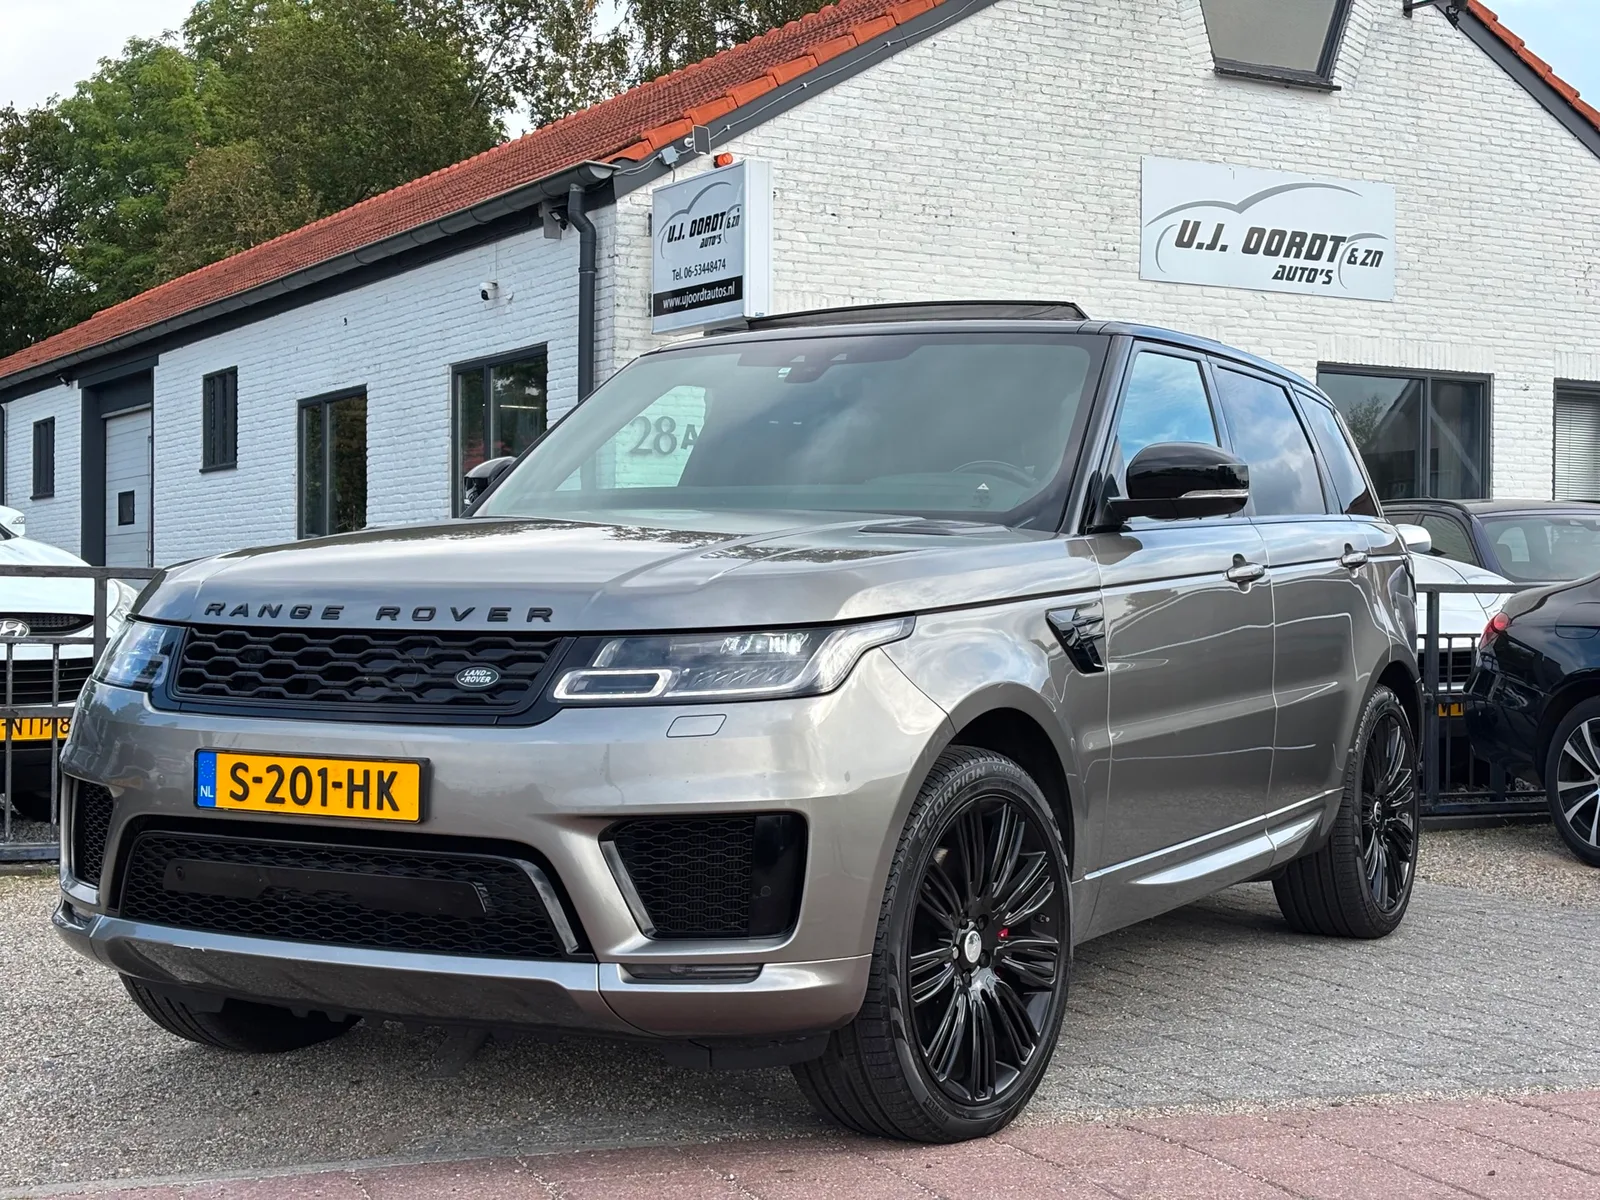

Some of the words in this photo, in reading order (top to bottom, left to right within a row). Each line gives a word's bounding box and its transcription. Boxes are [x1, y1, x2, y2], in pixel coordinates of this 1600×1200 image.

[667, 222, 685, 243] U.J.
[689, 211, 726, 238] OORDT
[1174, 219, 1229, 253] U.J.
[1241, 226, 1348, 263] OORDT
[672, 269, 683, 281] Tel.
[684, 258, 726, 279] 06-53448474
[1271, 264, 1334, 285] AUTO'S
[663, 282, 735, 309] www.ujoordtautos.nl
[204, 602, 345, 621] RANGE
[375, 606, 554, 623] ROVER
[200, 786, 214, 798] NL
[229, 762, 400, 812] S-201-HK
[918, 766, 986, 845] SCORPION
